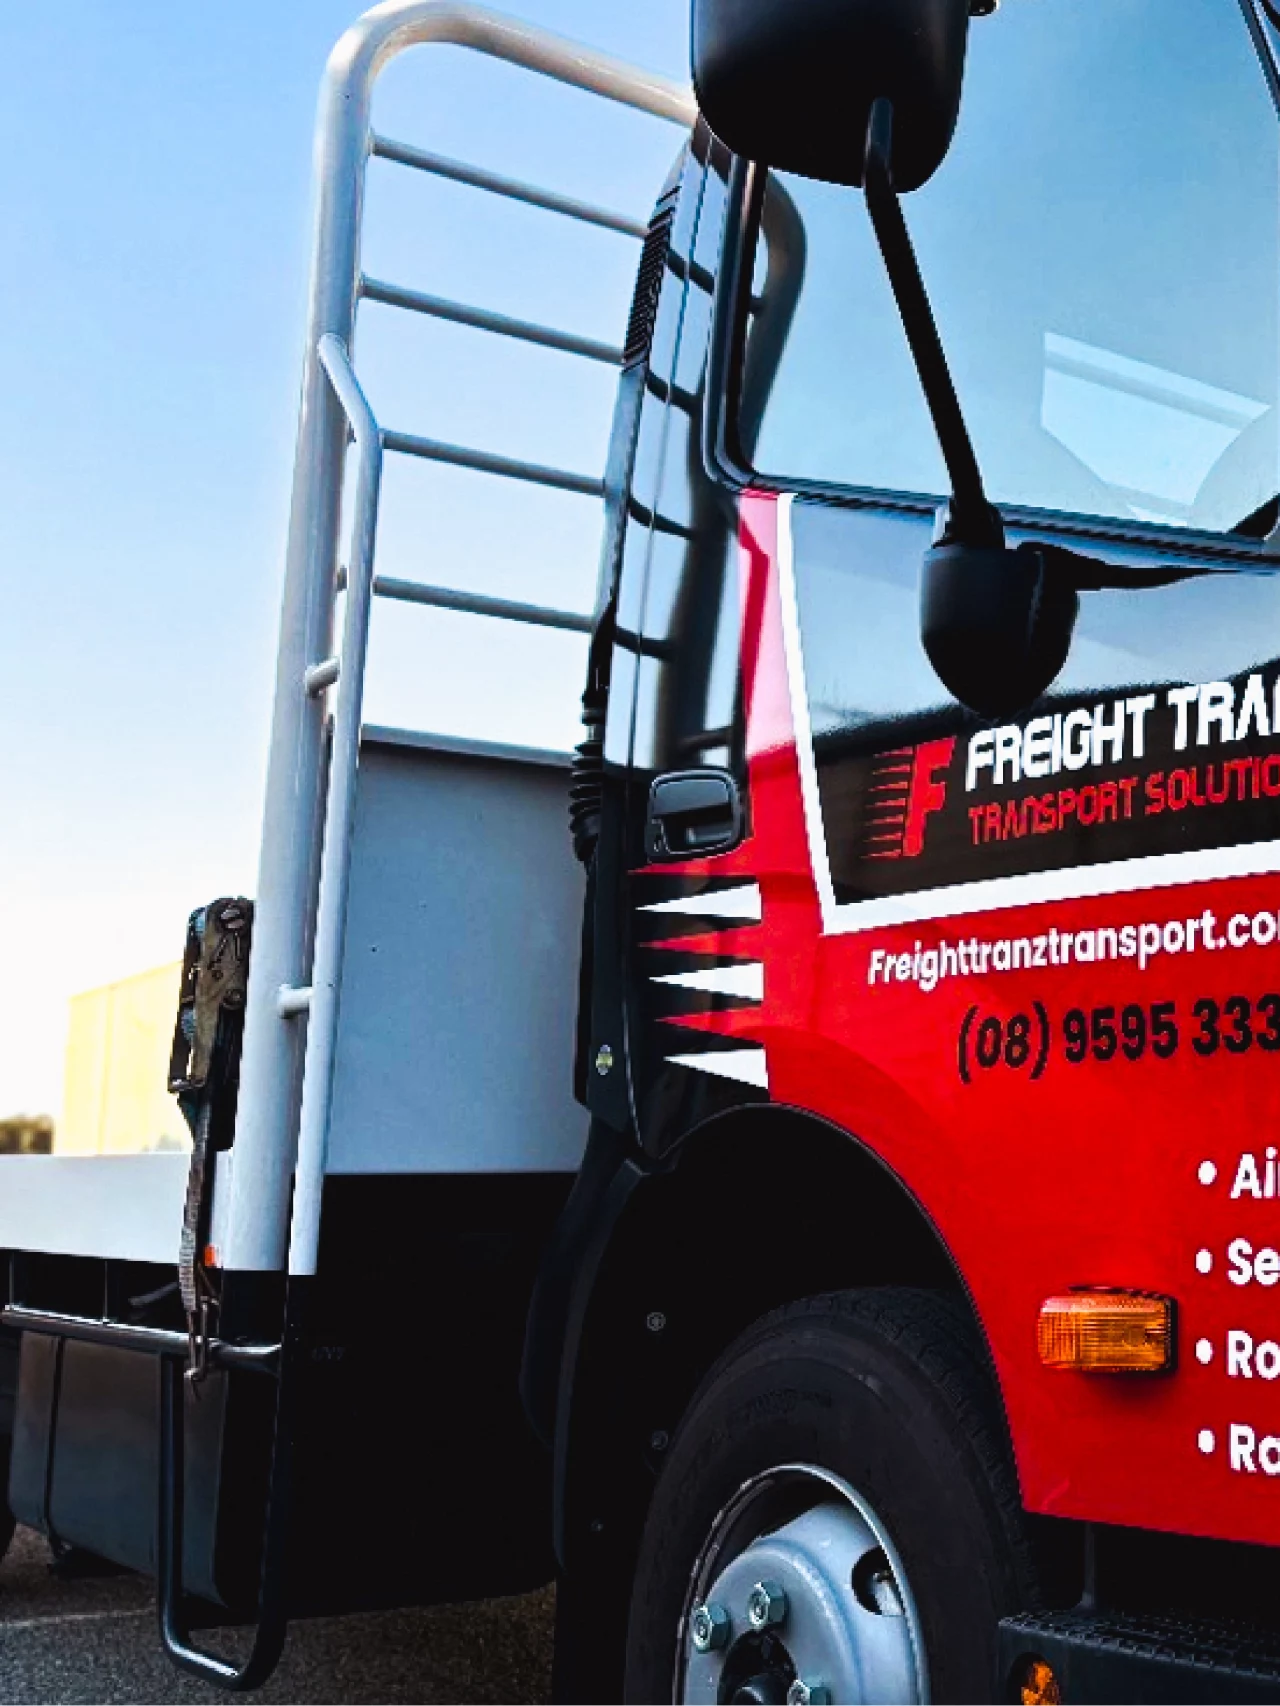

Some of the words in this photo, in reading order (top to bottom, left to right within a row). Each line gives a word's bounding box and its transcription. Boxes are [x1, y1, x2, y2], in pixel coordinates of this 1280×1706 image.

[964, 693, 1157, 792] FREIGHT
[968, 777, 1138, 845] TRANSPORT
[956, 1001, 1052, 1084] (08)
[1063, 1003, 1179, 1062] 9595
